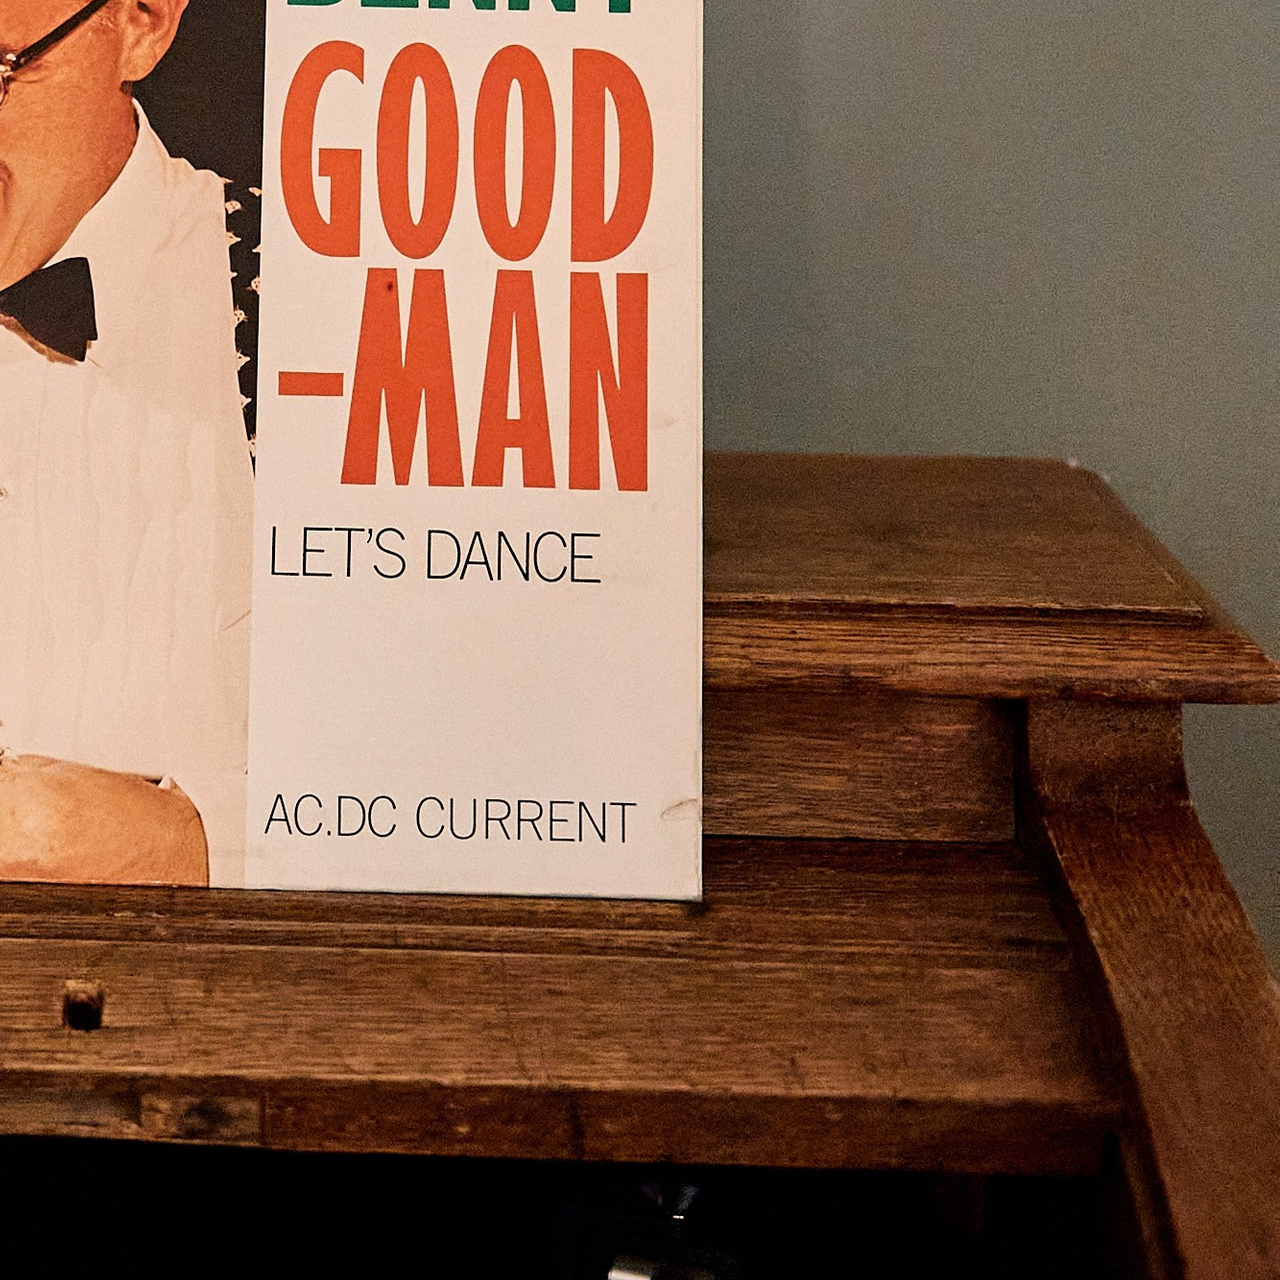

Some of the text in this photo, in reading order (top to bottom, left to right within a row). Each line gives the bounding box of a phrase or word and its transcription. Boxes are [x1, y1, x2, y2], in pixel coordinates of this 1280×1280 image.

[280, 40, 654, 263] GOOD
[270, 526, 602, 584] LET'S DANCE
[263, 793, 638, 843] AC.DC CURRENT
